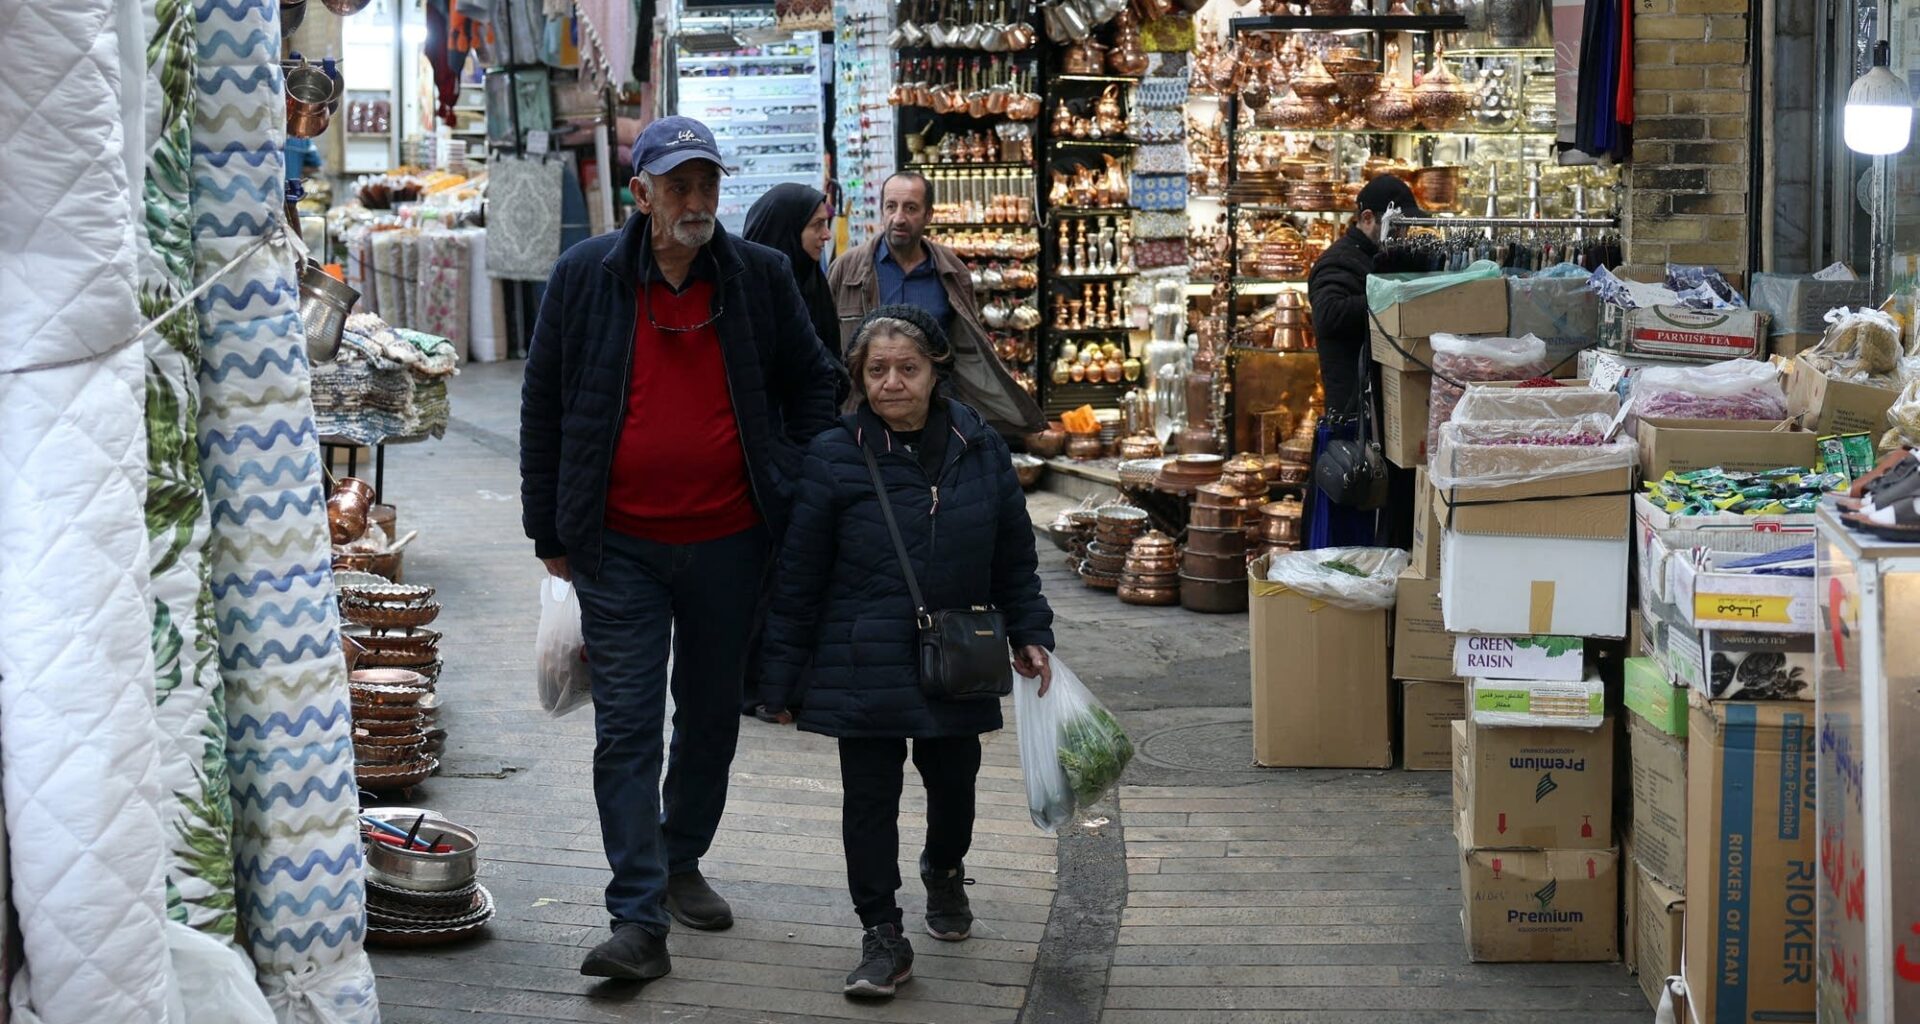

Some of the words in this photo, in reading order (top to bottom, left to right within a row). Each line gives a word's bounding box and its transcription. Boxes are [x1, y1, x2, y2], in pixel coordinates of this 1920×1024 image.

[1657, 331, 1706, 344] PARMISE
[1709, 335, 1731, 346] TEA
[1718, 604, 1762, 618] ممتاز
[1468, 636, 1514, 651] GREEN
[1467, 653, 1513, 668] RAISIN
[1786, 717, 1800, 739] Tin
[1509, 757, 1585, 772] Premium
[1782, 782, 1797, 835] Portable
[1727, 833, 1743, 902] RIOKER
[1507, 909, 1584, 923] Premium
[1783, 860, 1817, 985] RIOKER
[1725, 938, 1740, 985] IRAN
